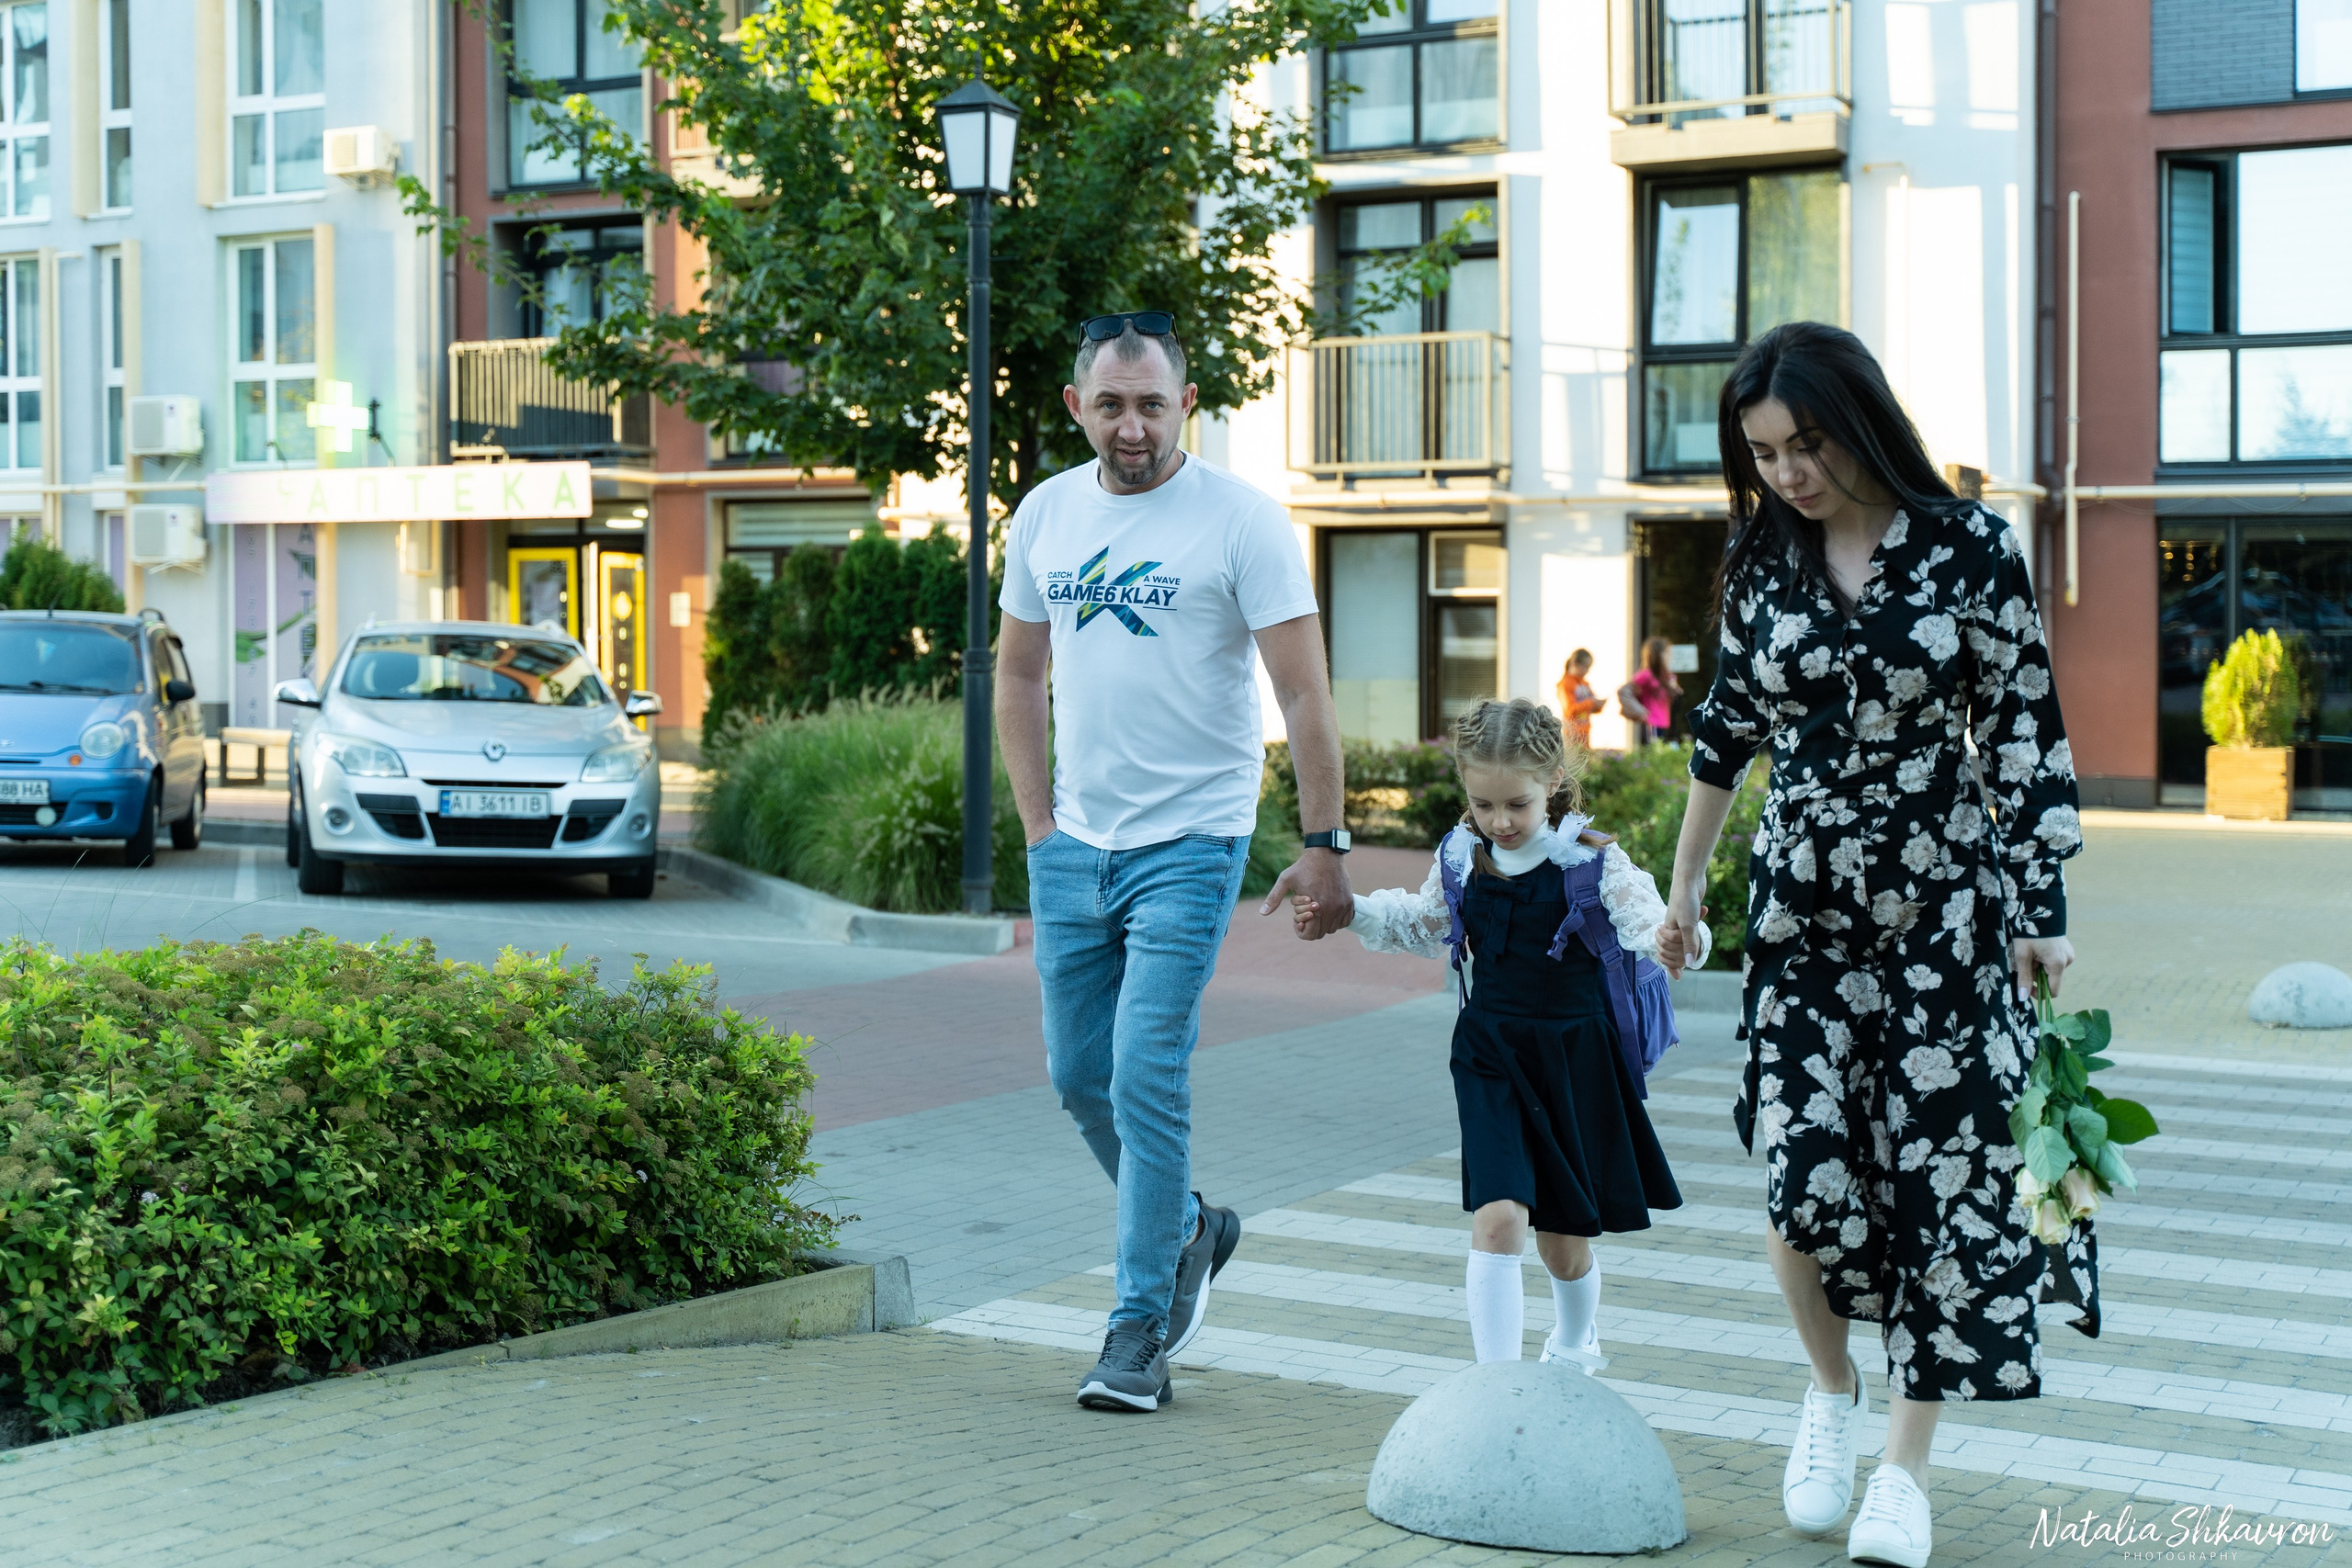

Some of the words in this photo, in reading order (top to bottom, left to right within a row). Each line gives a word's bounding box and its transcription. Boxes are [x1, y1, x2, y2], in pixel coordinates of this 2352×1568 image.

[307, 470, 578, 515] АПТЕКА
[1047, 570, 1073, 580] CATCH
[1152, 575, 1181, 586] WAVE
[1047, 583, 1117, 604] GAME6
[1120, 586, 1177, 607] KLAY
[451, 794, 471, 812] AI
[479, 794, 516, 812] 3611
[522, 795, 543, 813] IB
